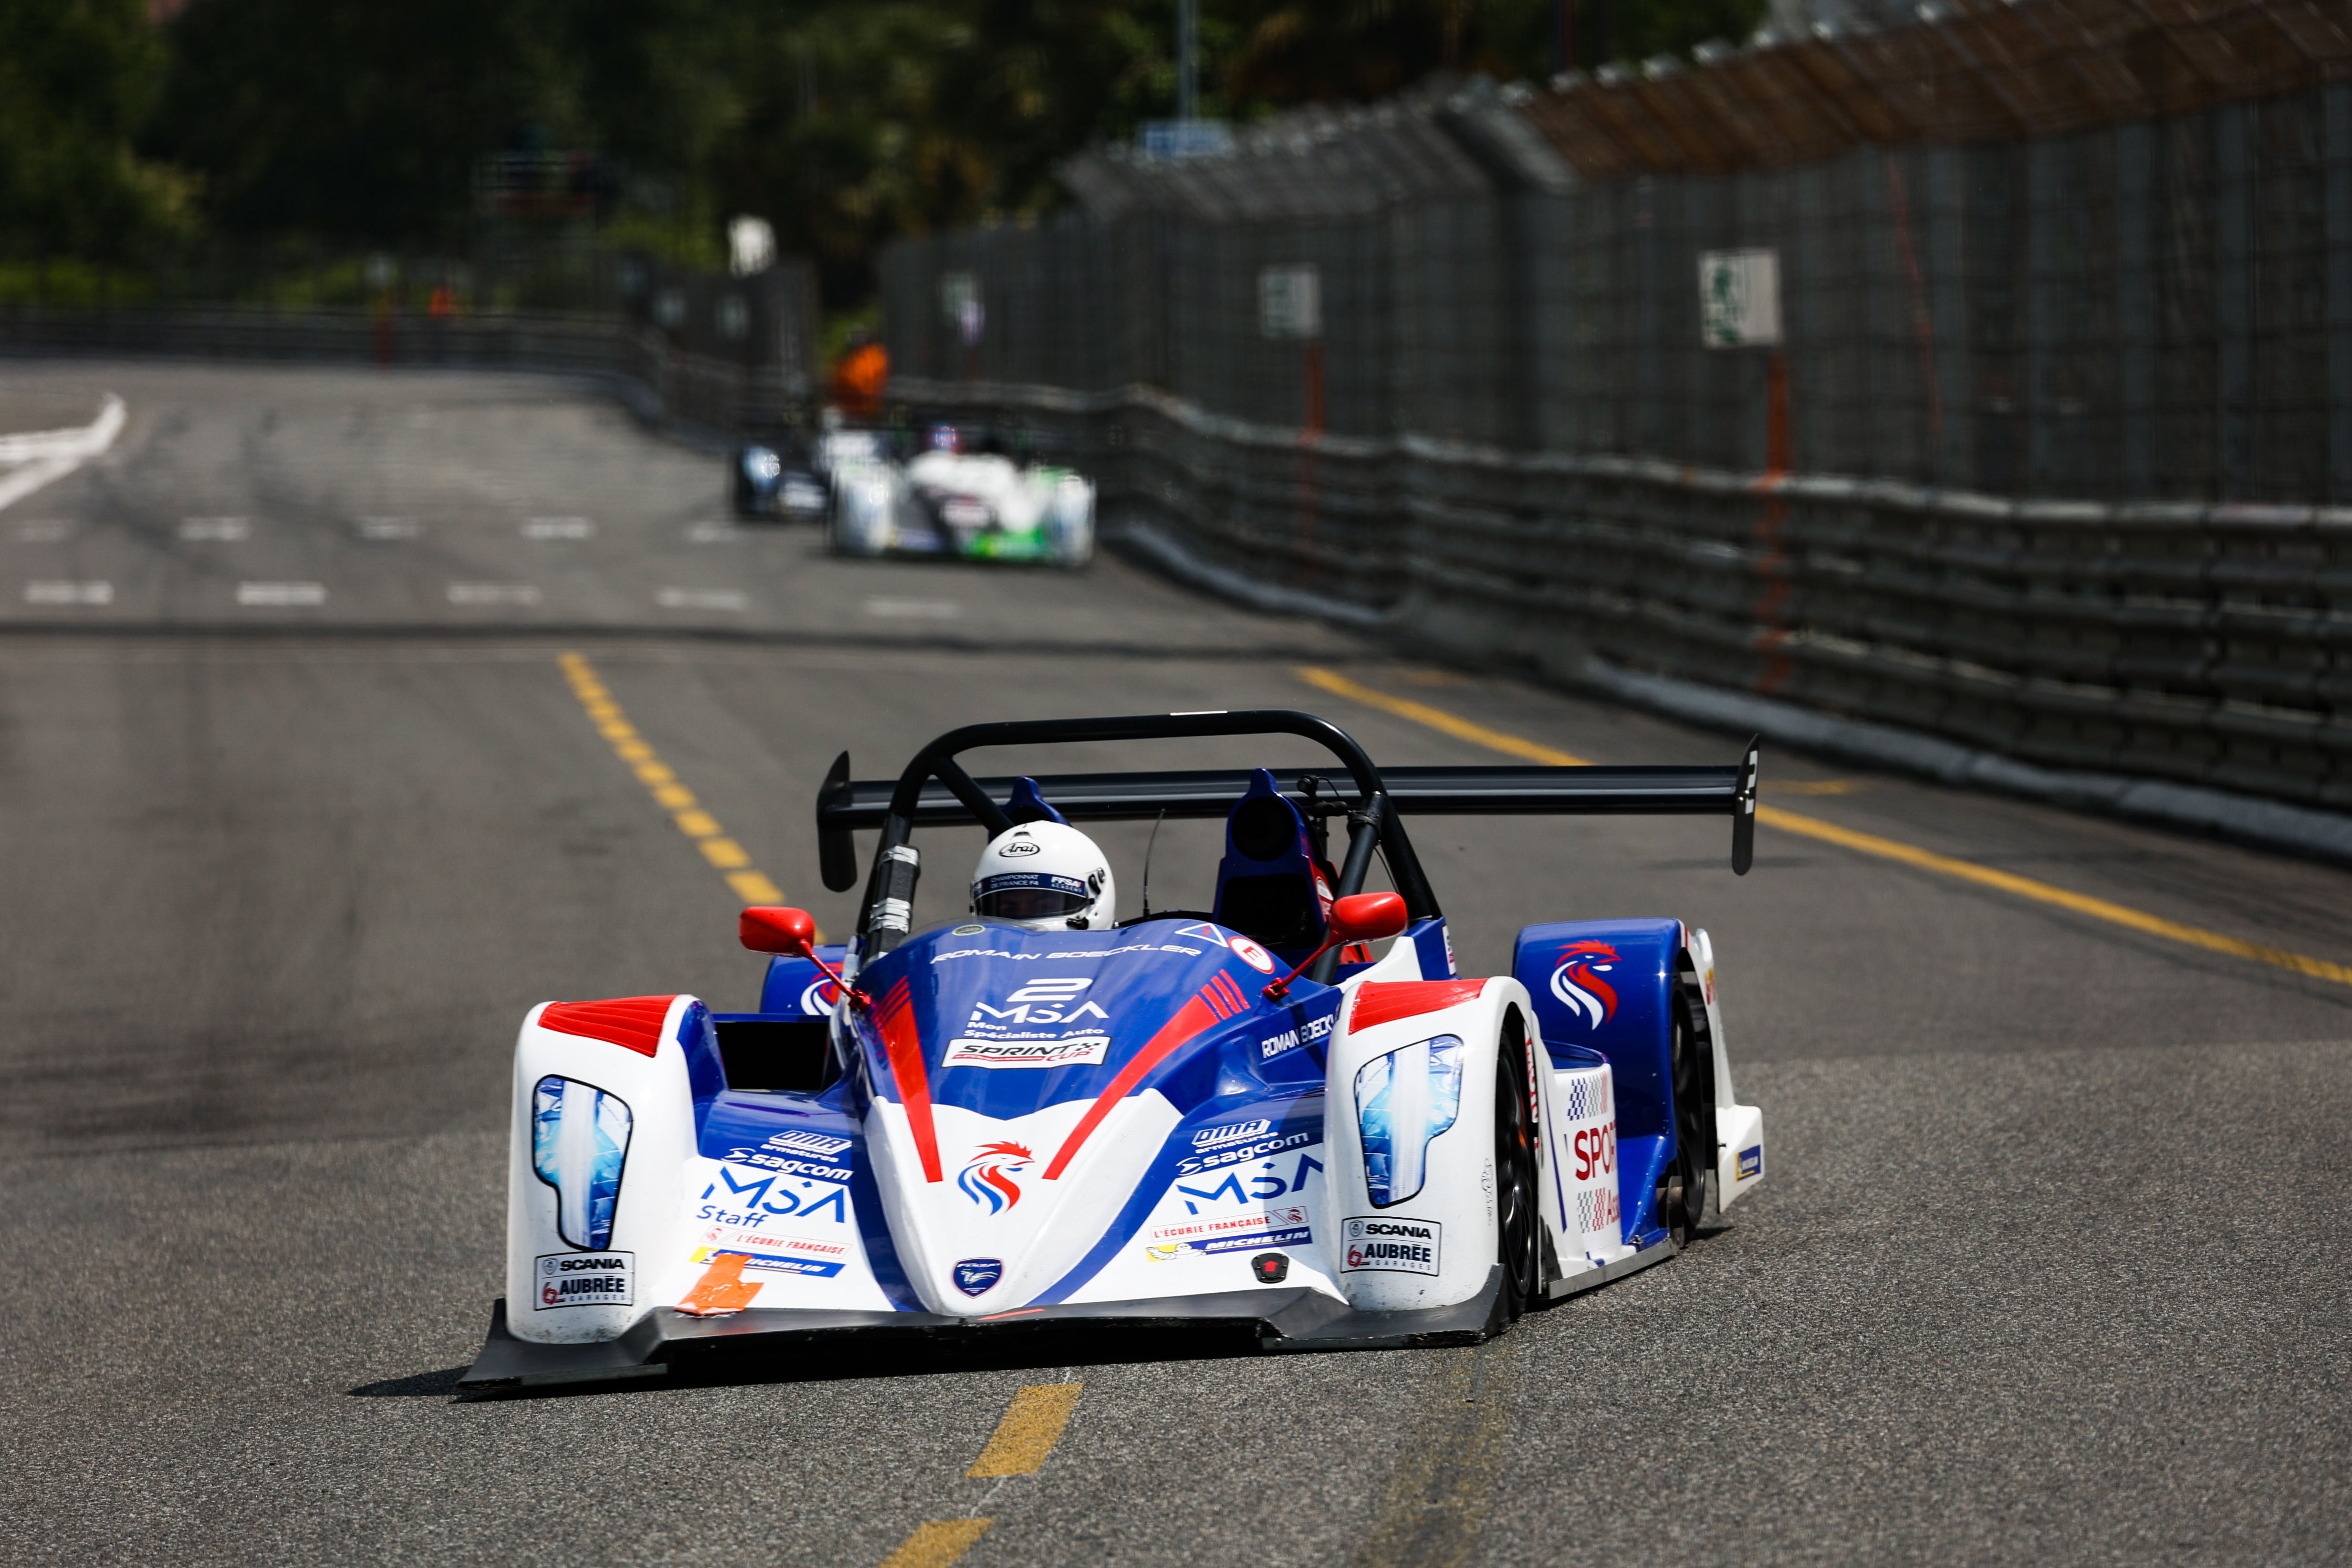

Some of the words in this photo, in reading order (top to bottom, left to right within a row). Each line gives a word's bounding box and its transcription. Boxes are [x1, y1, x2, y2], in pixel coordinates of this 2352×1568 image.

[1007, 843, 1034, 853] Arai
[990, 874, 1039, 883] CHAMPIONNAT
[1051, 876, 1081, 887] FFSA
[1050, 884, 1082, 893] ACADEMY
[930, 950, 1042, 964] ROMAIN
[1045, 944, 1202, 960] BOECKLER
[1242, 946, 1263, 962] E
[1006, 978, 1093, 1002] 2
[970, 1000, 1110, 1023] MSA
[963, 1029, 1057, 1039] Spécialiste
[1060, 1027, 1105, 1038] Auto
[967, 1022, 1007, 1031] Mon
[958, 1044, 1078, 1056] SPRINT
[1046, 1051, 1090, 1061] CUP
[1195, 1131, 1279, 1154] armatures
[1202, 1132, 1309, 1168] sagcom
[760, 1144, 840, 1163] armatures
[747, 1153, 854, 1181] sagcom
[700, 1166, 846, 1223] MSA
[696, 1205, 769, 1228] Staff
[1154, 1226, 1204, 1238] L'ÉCURIE
[1209, 1216, 1271, 1231] FRANÇAISE
[1366, 1223, 1432, 1240] SCANIA
[737, 1234, 784, 1248] L'ÉCURIE
[785, 1241, 845, 1255] FRANÇAISE
[1204, 1231, 1309, 1250] MICHELIN
[560, 1258, 626, 1272] SCANIA
[1375, 1260, 1431, 1270] GARAGES
